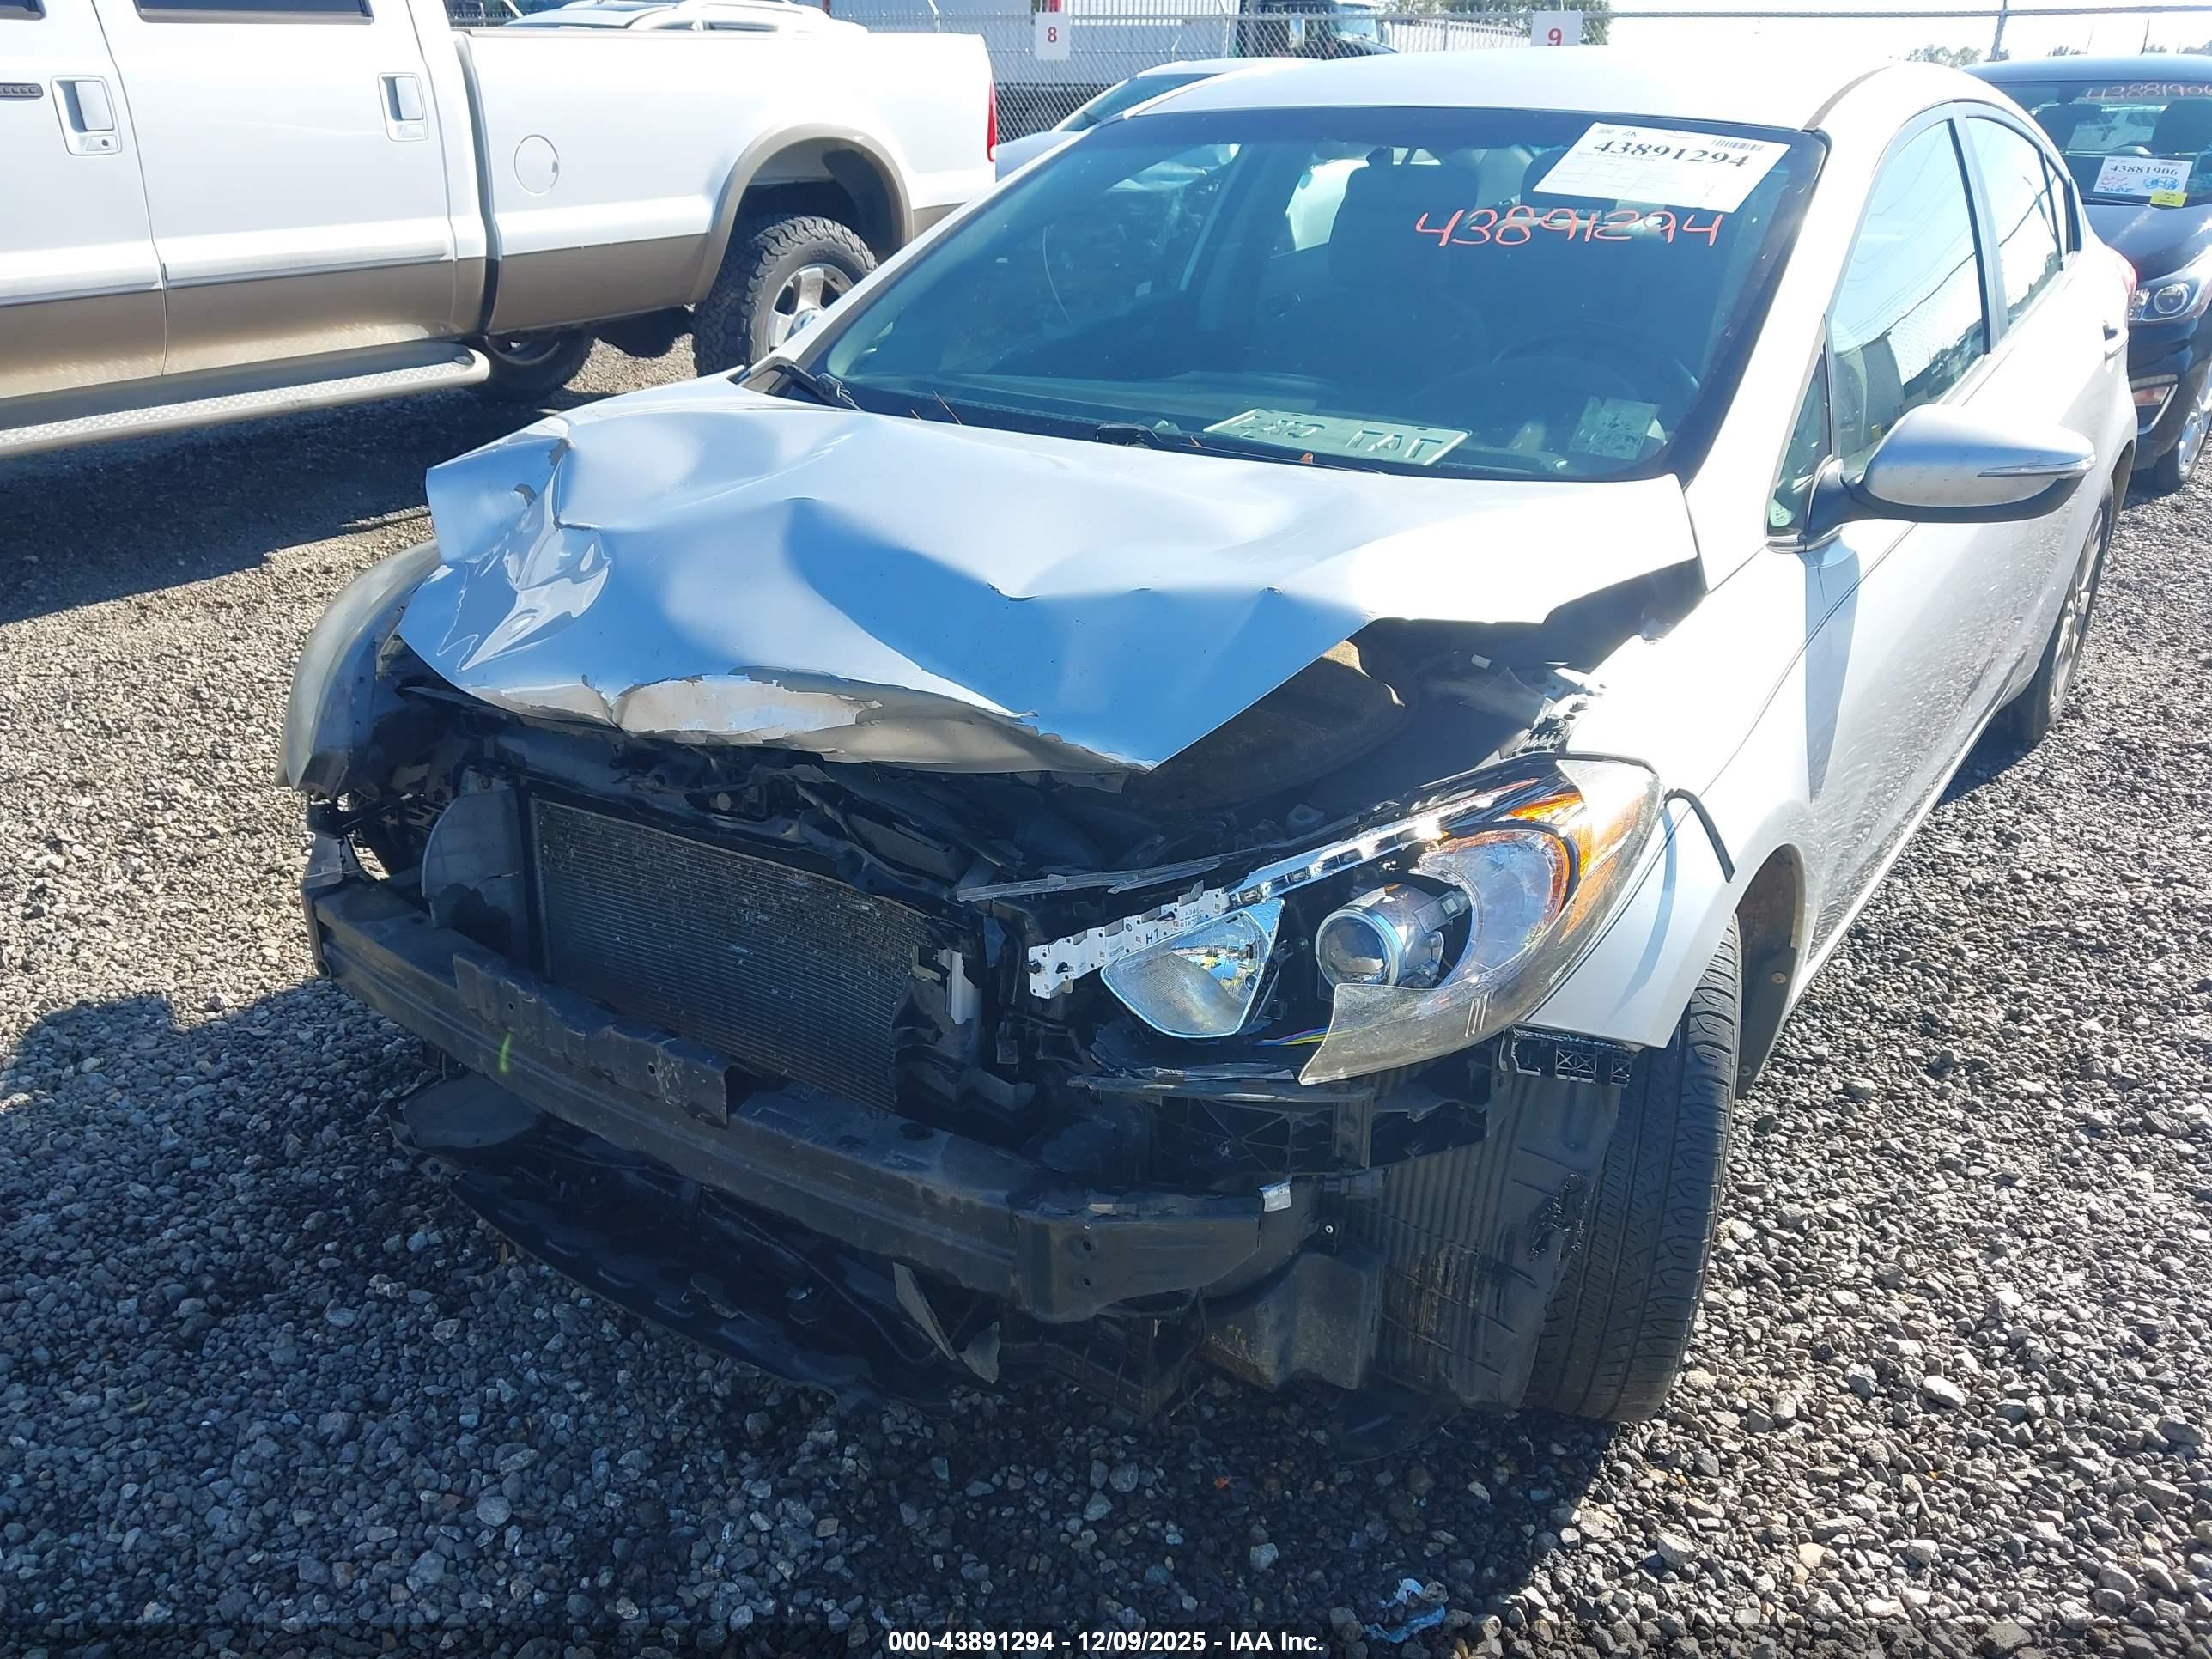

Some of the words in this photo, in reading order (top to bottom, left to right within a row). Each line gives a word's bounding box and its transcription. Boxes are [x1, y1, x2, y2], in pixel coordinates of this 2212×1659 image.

[1048, 27, 1057, 43] 8
[1548, 27, 1562, 46] 9
[1594, 140, 1750, 167] 43891294
[2110, 164, 2179, 176] 43881906
[1415, 205, 1723, 246] 43891294
